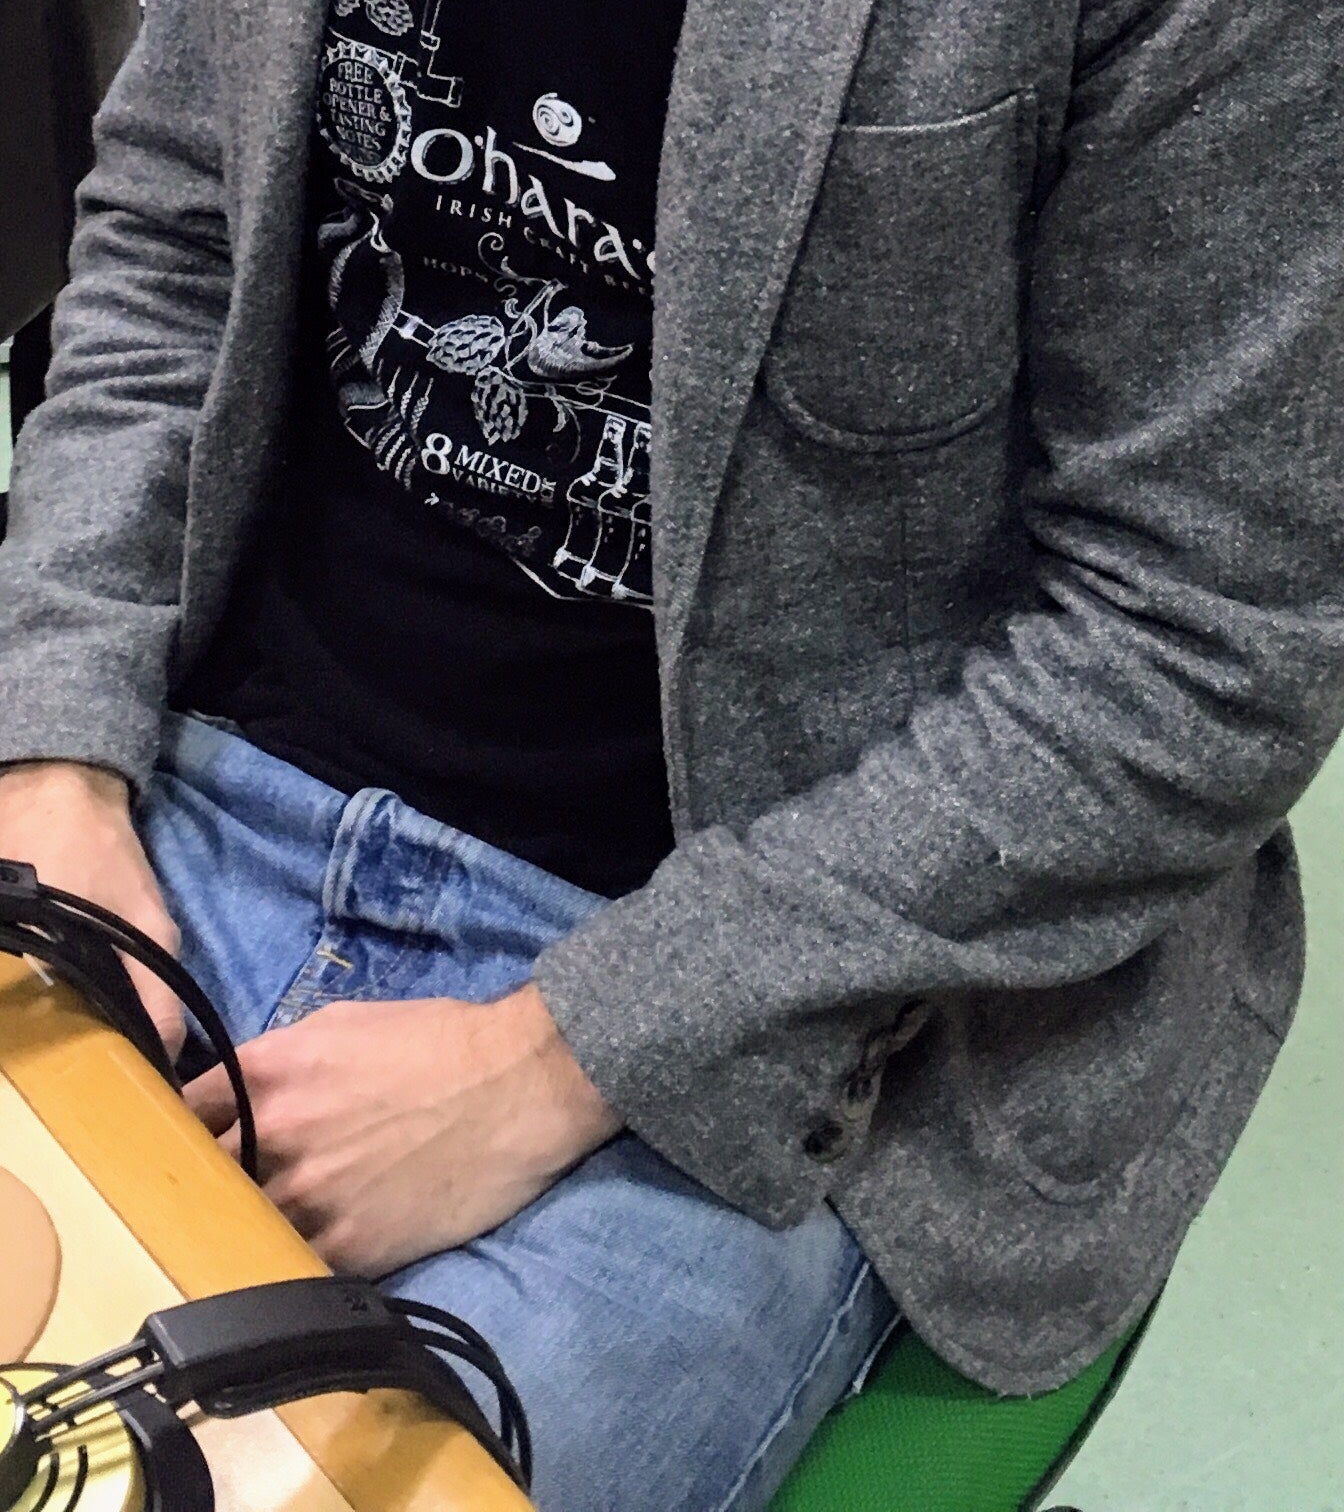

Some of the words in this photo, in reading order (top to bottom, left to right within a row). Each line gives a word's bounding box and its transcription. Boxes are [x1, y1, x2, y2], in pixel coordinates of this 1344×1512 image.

[435, 194, 513, 229] IRISH
[420, 432, 453, 476] 8
[454, 444, 542, 494] MIXED
